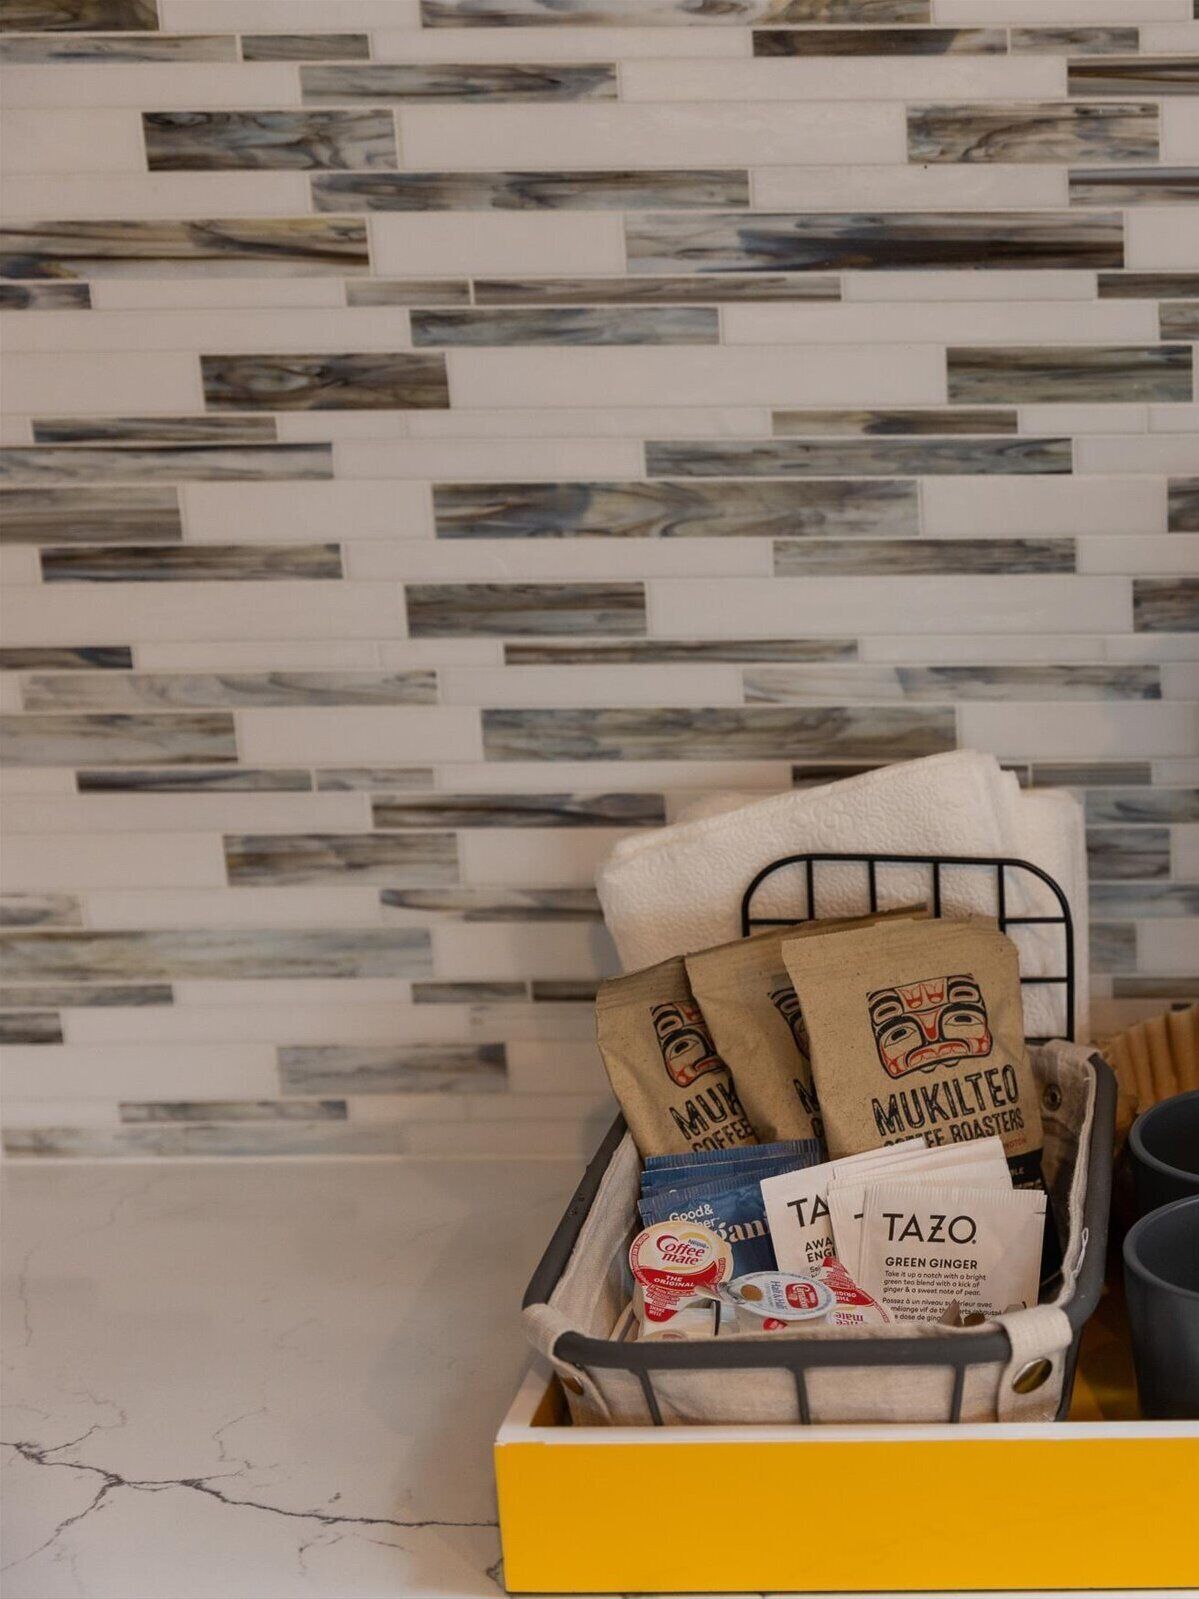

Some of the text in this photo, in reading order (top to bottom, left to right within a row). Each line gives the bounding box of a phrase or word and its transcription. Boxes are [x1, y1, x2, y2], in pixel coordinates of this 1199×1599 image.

[871, 1064, 1019, 1136] MUKILTEO
[950, 1107, 1025, 1144] ROASTERS
[882, 1213, 977, 1244] TAZO
[656, 1235, 705, 1257] Coffee
[661, 1253, 699, 1266] mate
[885, 1257, 978, 1270] GREEN GINGER
[884, 1270, 899, 1278] Take
[907, 1272, 916, 1280] up
[966, 1273, 987, 1281] bright
[653, 1277, 695, 1288] ORIGINAL
[916, 1279, 935, 1287] blend
[958, 1280, 971, 1288] kick
